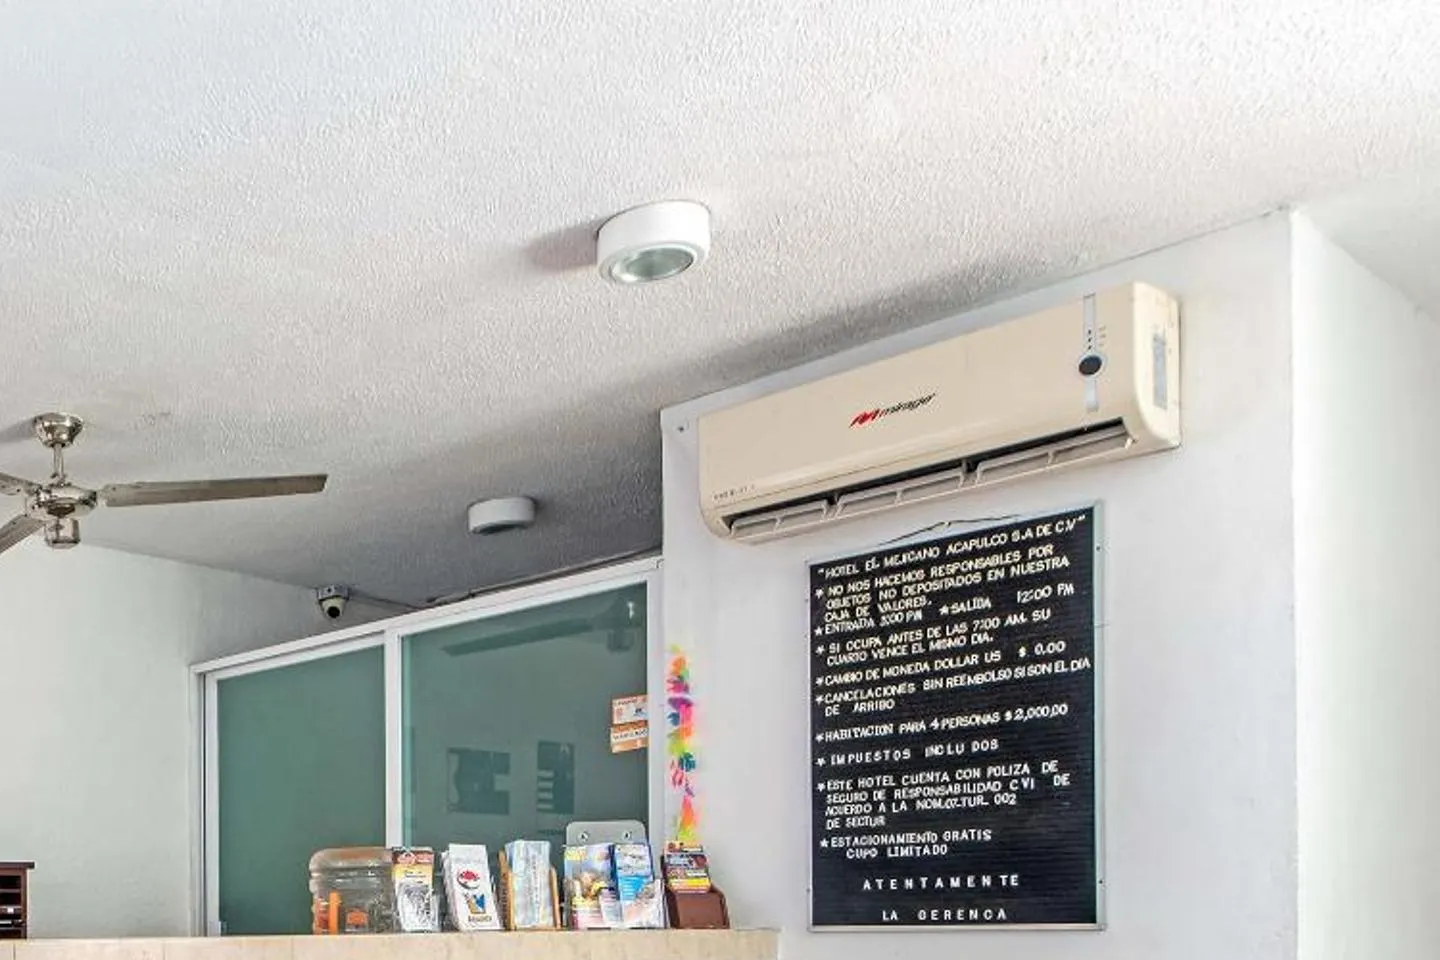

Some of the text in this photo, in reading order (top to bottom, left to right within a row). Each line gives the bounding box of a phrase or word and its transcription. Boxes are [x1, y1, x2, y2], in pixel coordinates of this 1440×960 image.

[946, 533, 1008, 555] ACAPULCO
[1036, 523, 1053, 538] DE
[828, 585, 844, 597] NO
[875, 569, 926, 588] HACEMOS
[930, 550, 1021, 578] RESPONSABLES
[1028, 543, 1054, 560] POR
[825, 555, 1070, 610] OBJETOS NO DEPOSITADOS EN NUESTRA
[824, 609, 850, 623] CAJA
[855, 605, 870, 618] DE
[825, 618, 875, 635] ENTRADA
[829, 642, 840, 654] SI
[887, 629, 923, 645] ANTES
[927, 627, 942, 640] DE
[946, 622, 968, 636] LAS
[1032, 608, 1051, 621] SU
[827, 650, 867, 666] CUARTO
[871, 644, 908, 659] VENCE
[911, 642, 925, 654] EL
[929, 635, 967, 651] MISMO
[825, 671, 862, 686] CAMBIO
[865, 667, 880, 680] DE
[883, 661, 930, 678] MONEDA
[934, 654, 979, 670] DOLLAR
[984, 650, 1001, 663] US
[825, 657, 1091, 704] CANCELACIONES SIN REEMBOLSO SI SON EL DIA
[825, 698, 895, 717] DE ARRIBO
[825, 723, 893, 742] HABITACION
[899, 720, 926, 734] PARA
[831, 748, 911, 765] IMPUESTOS
[827, 760, 1058, 791] ESTE HOTEL CUENTA CON POLIZA DE
[826, 790, 868, 804] SEGURO
[873, 788, 886, 801] DE
[894, 780, 1002, 800] RESPONSABILIDAD
[1053, 773, 1070, 786] DE
[825, 802, 872, 816] ACUERDO
[879, 802, 886, 813] A
[892, 800, 907, 813] LA
[825, 815, 886, 830] DE SECTUR
[831, 829, 992, 848] ESTACIONAMIENTO GRATIS
[846, 844, 948, 859] CUPO LIMITADO
[863, 874, 1019, 890] ATENTAMENTE
[882, 908, 1007, 921] LA GERENCA
